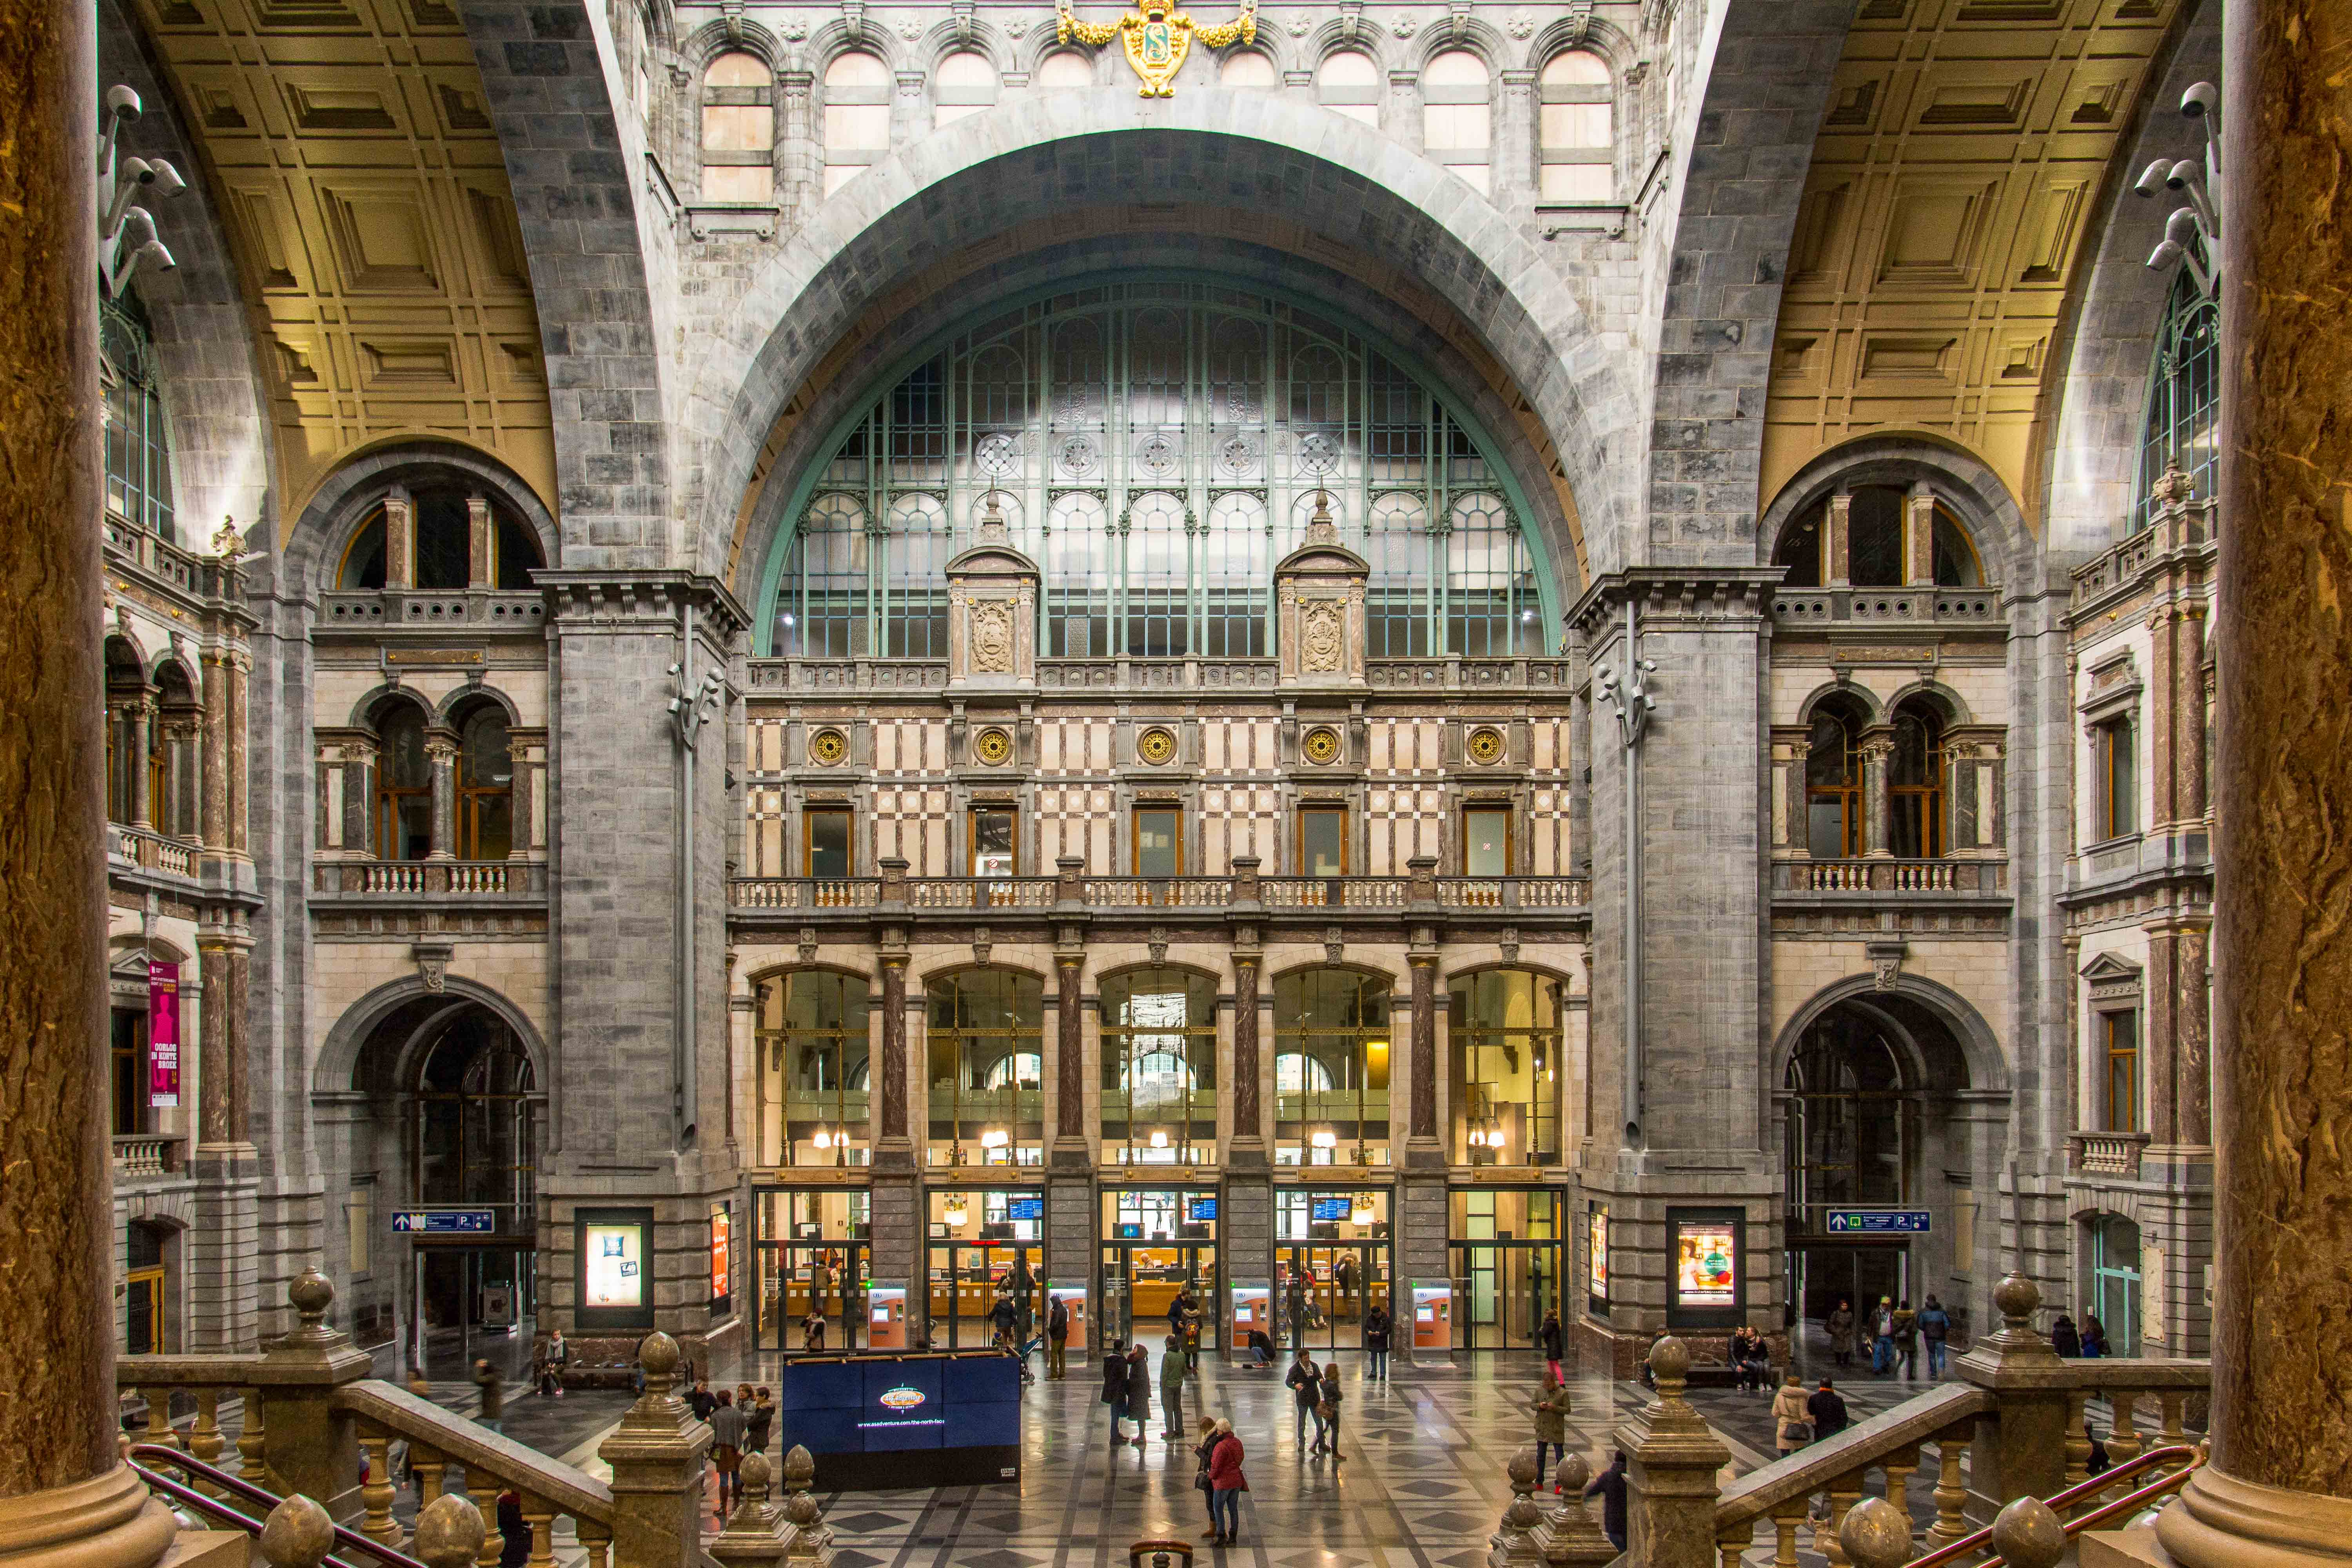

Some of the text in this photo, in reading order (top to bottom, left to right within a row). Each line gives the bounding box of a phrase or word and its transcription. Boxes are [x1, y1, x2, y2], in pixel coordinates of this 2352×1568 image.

[155, 1043, 177, 1052] OORLOG
[151, 1052, 177, 1060] IN KORTE
[158, 1060, 177, 1069] BROEK
[461, 1216, 468, 1225] P
[1898, 1216, 1905, 1225] P
